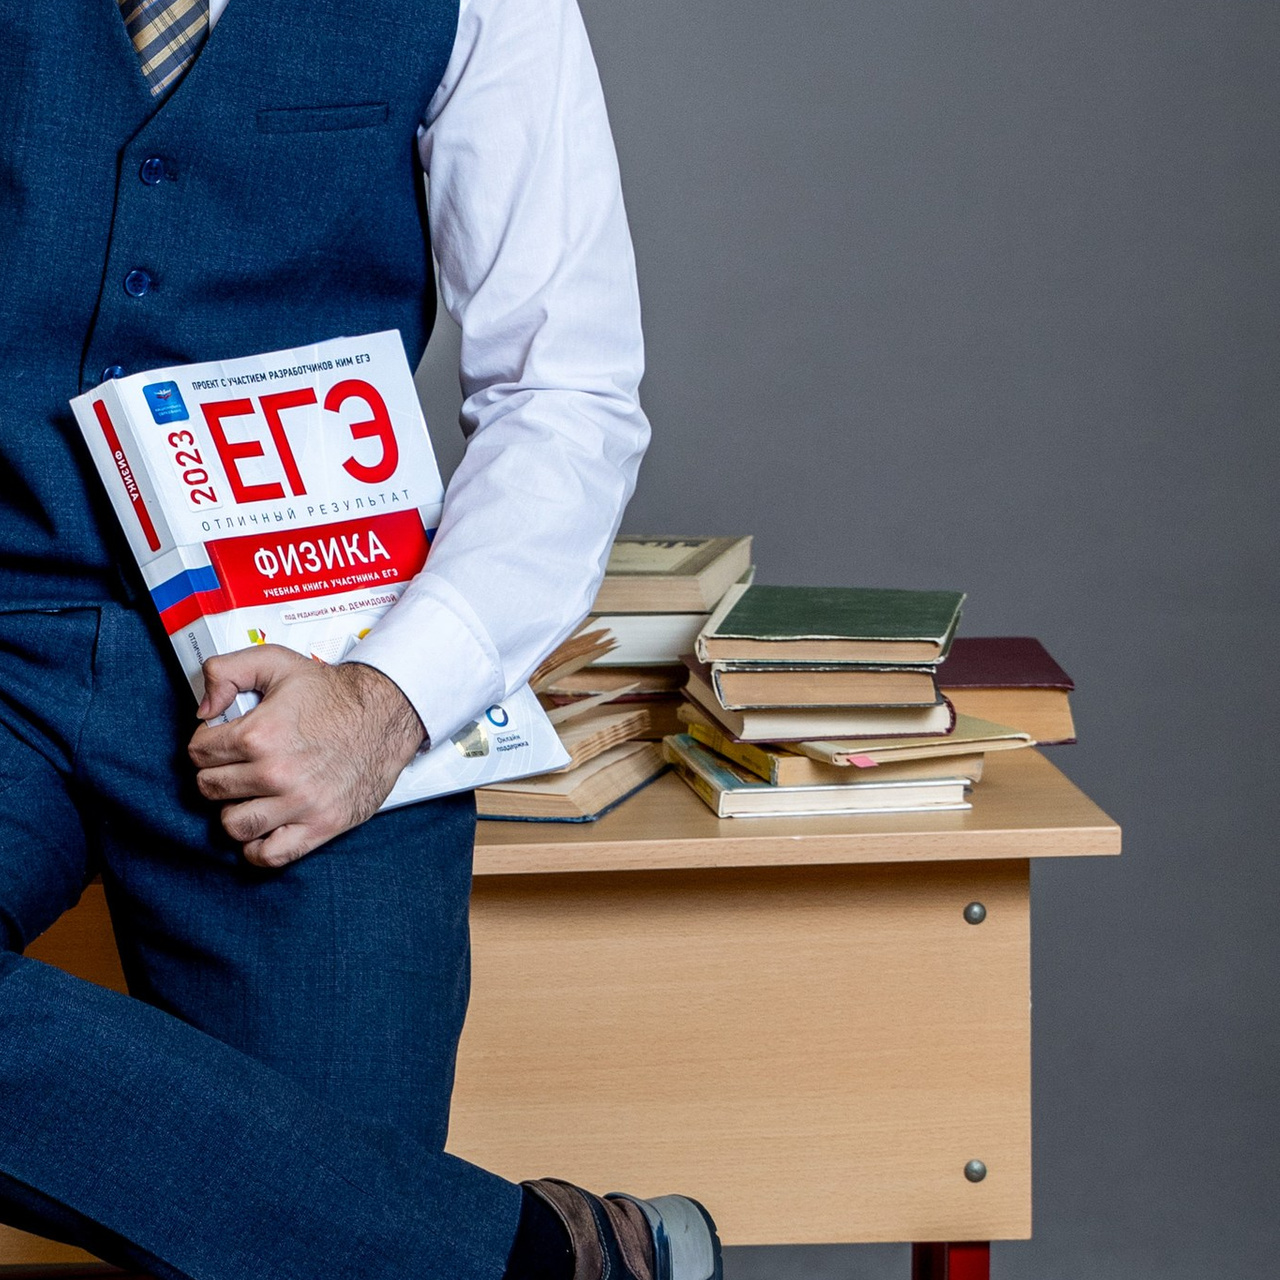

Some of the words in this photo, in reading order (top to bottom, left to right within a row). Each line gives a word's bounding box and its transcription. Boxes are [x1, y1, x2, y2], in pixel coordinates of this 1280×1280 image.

[192, 379, 219, 390] ПРОЕКТ
[221, 379, 227, 387] С
[227, 372, 267, 386] УЧАСТИЕМ
[269, 360, 333, 380] РАЗРАБОТЧИКОВ
[336, 357, 354, 368] КИМ
[355, 353, 371, 364] ЕГЭ
[200, 379, 399, 504] ЕГЭ
[115, 450, 139, 501] ФИЗИКА
[168, 430, 217, 505] 2023
[201, 507, 297, 532] ОТЛИЧНЫЙ
[308, 489, 410, 517] РЕЗУЛЬТАТ
[254, 530, 391, 578] ФИЗИКА
[263, 583, 300, 598] УЧЕБНАЯ
[303, 581, 329, 592] КНИГА
[331, 572, 380, 588] УЧАСТНИКА
[382, 568, 399, 578] ЕГЭ
[349, 594, 397, 611] ДЕМИДОВОЙ
